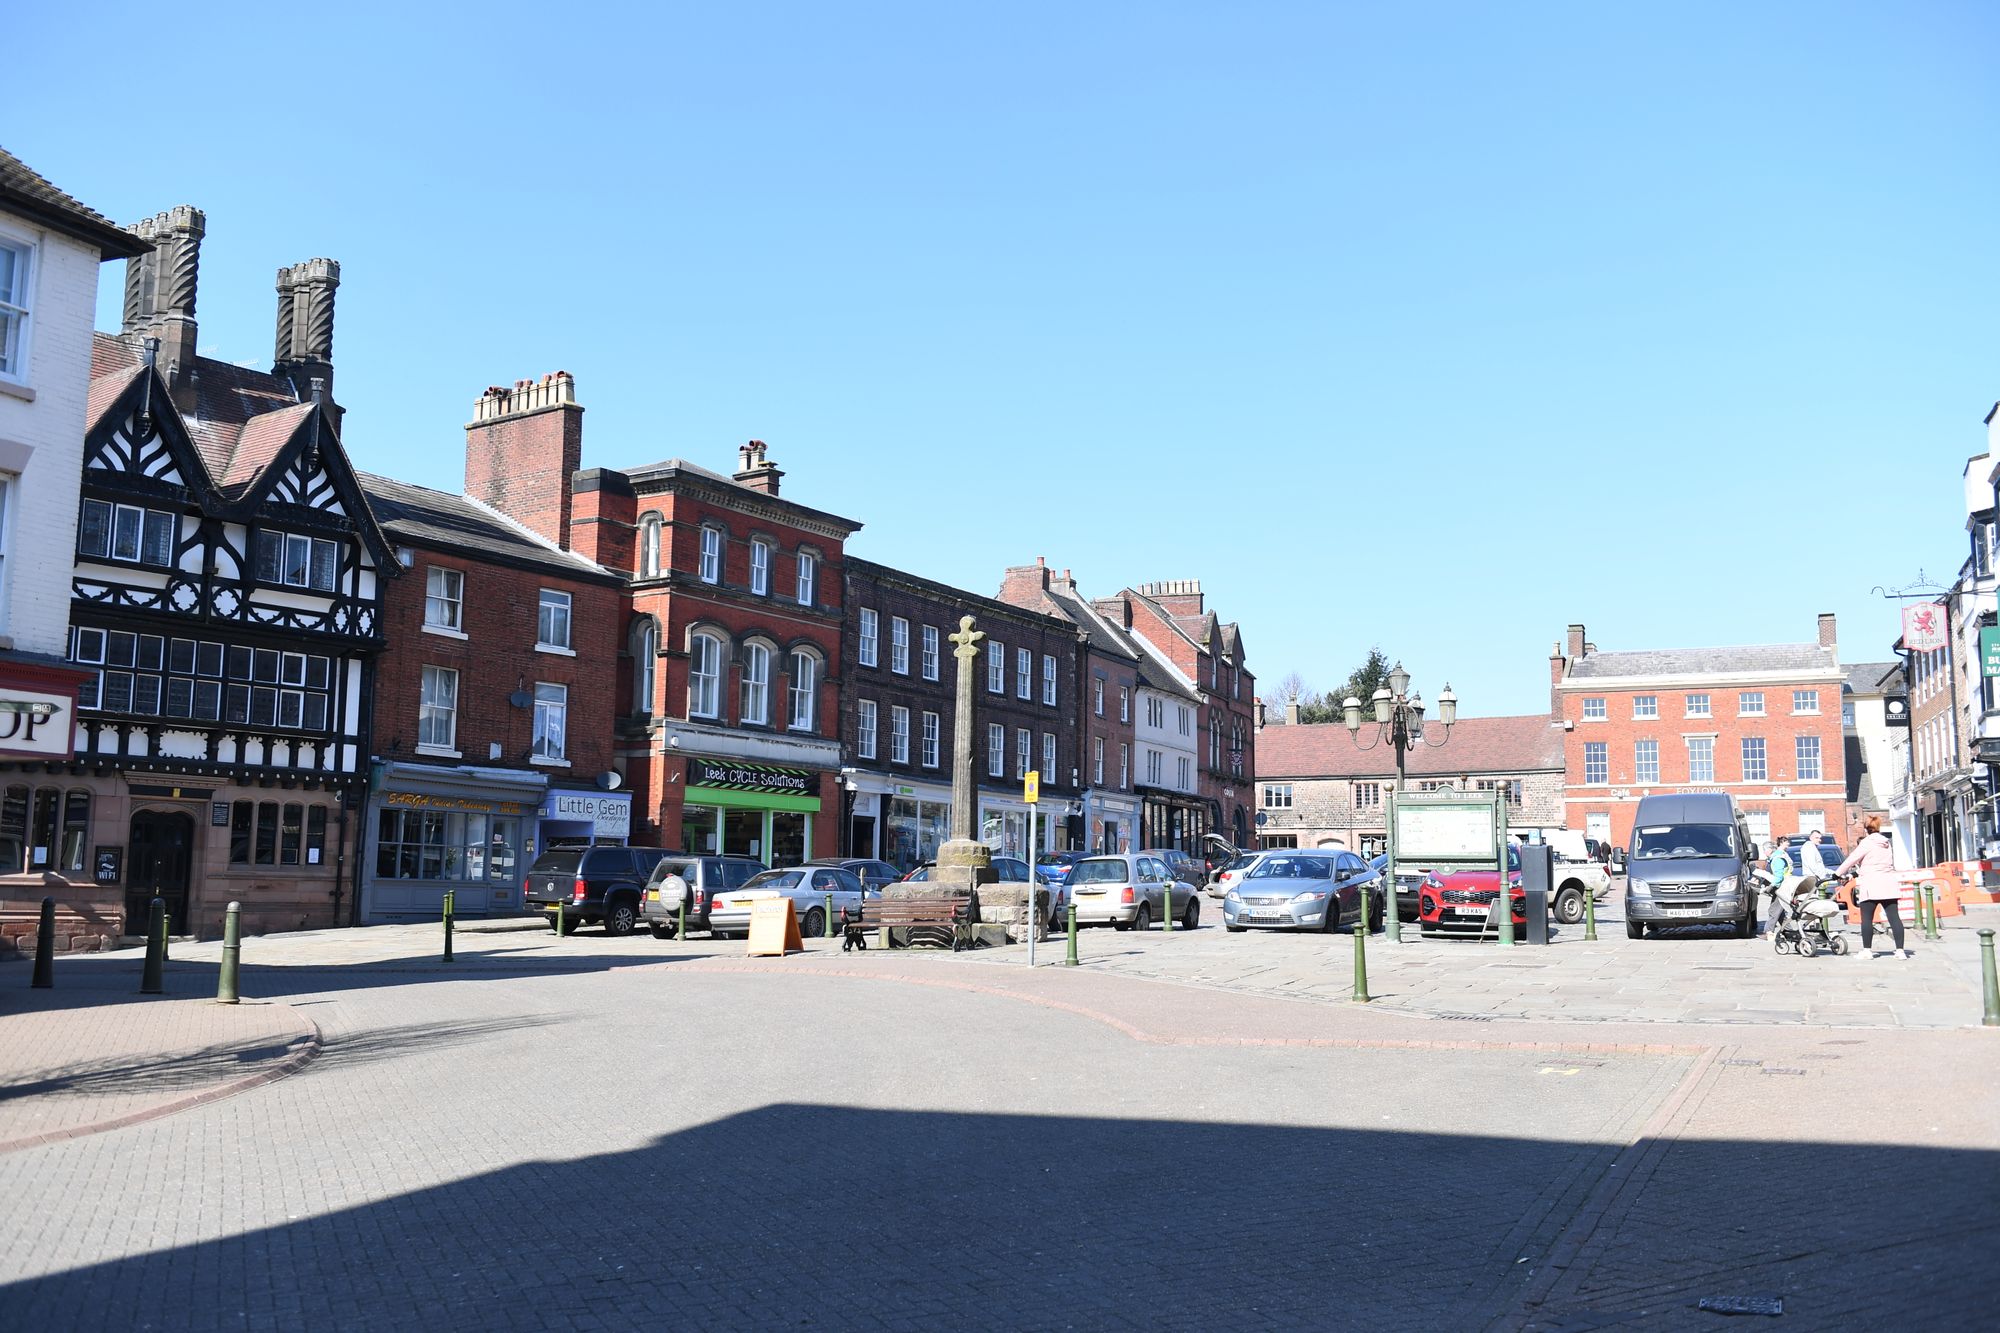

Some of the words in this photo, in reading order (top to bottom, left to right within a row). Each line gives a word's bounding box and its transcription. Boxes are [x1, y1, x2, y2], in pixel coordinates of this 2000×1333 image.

[1925, 637, 1943, 645] LION
[705, 767, 726, 781] Leek
[729, 769, 757, 784] CYCLE
[760, 773, 805, 789] Solutions
[1610, 788, 1630, 797] Café
[1771, 786, 1792, 795] Arts
[388, 792, 429, 809] SARGA
[559, 797, 594, 814] Little
[598, 799, 628, 816] Gem
